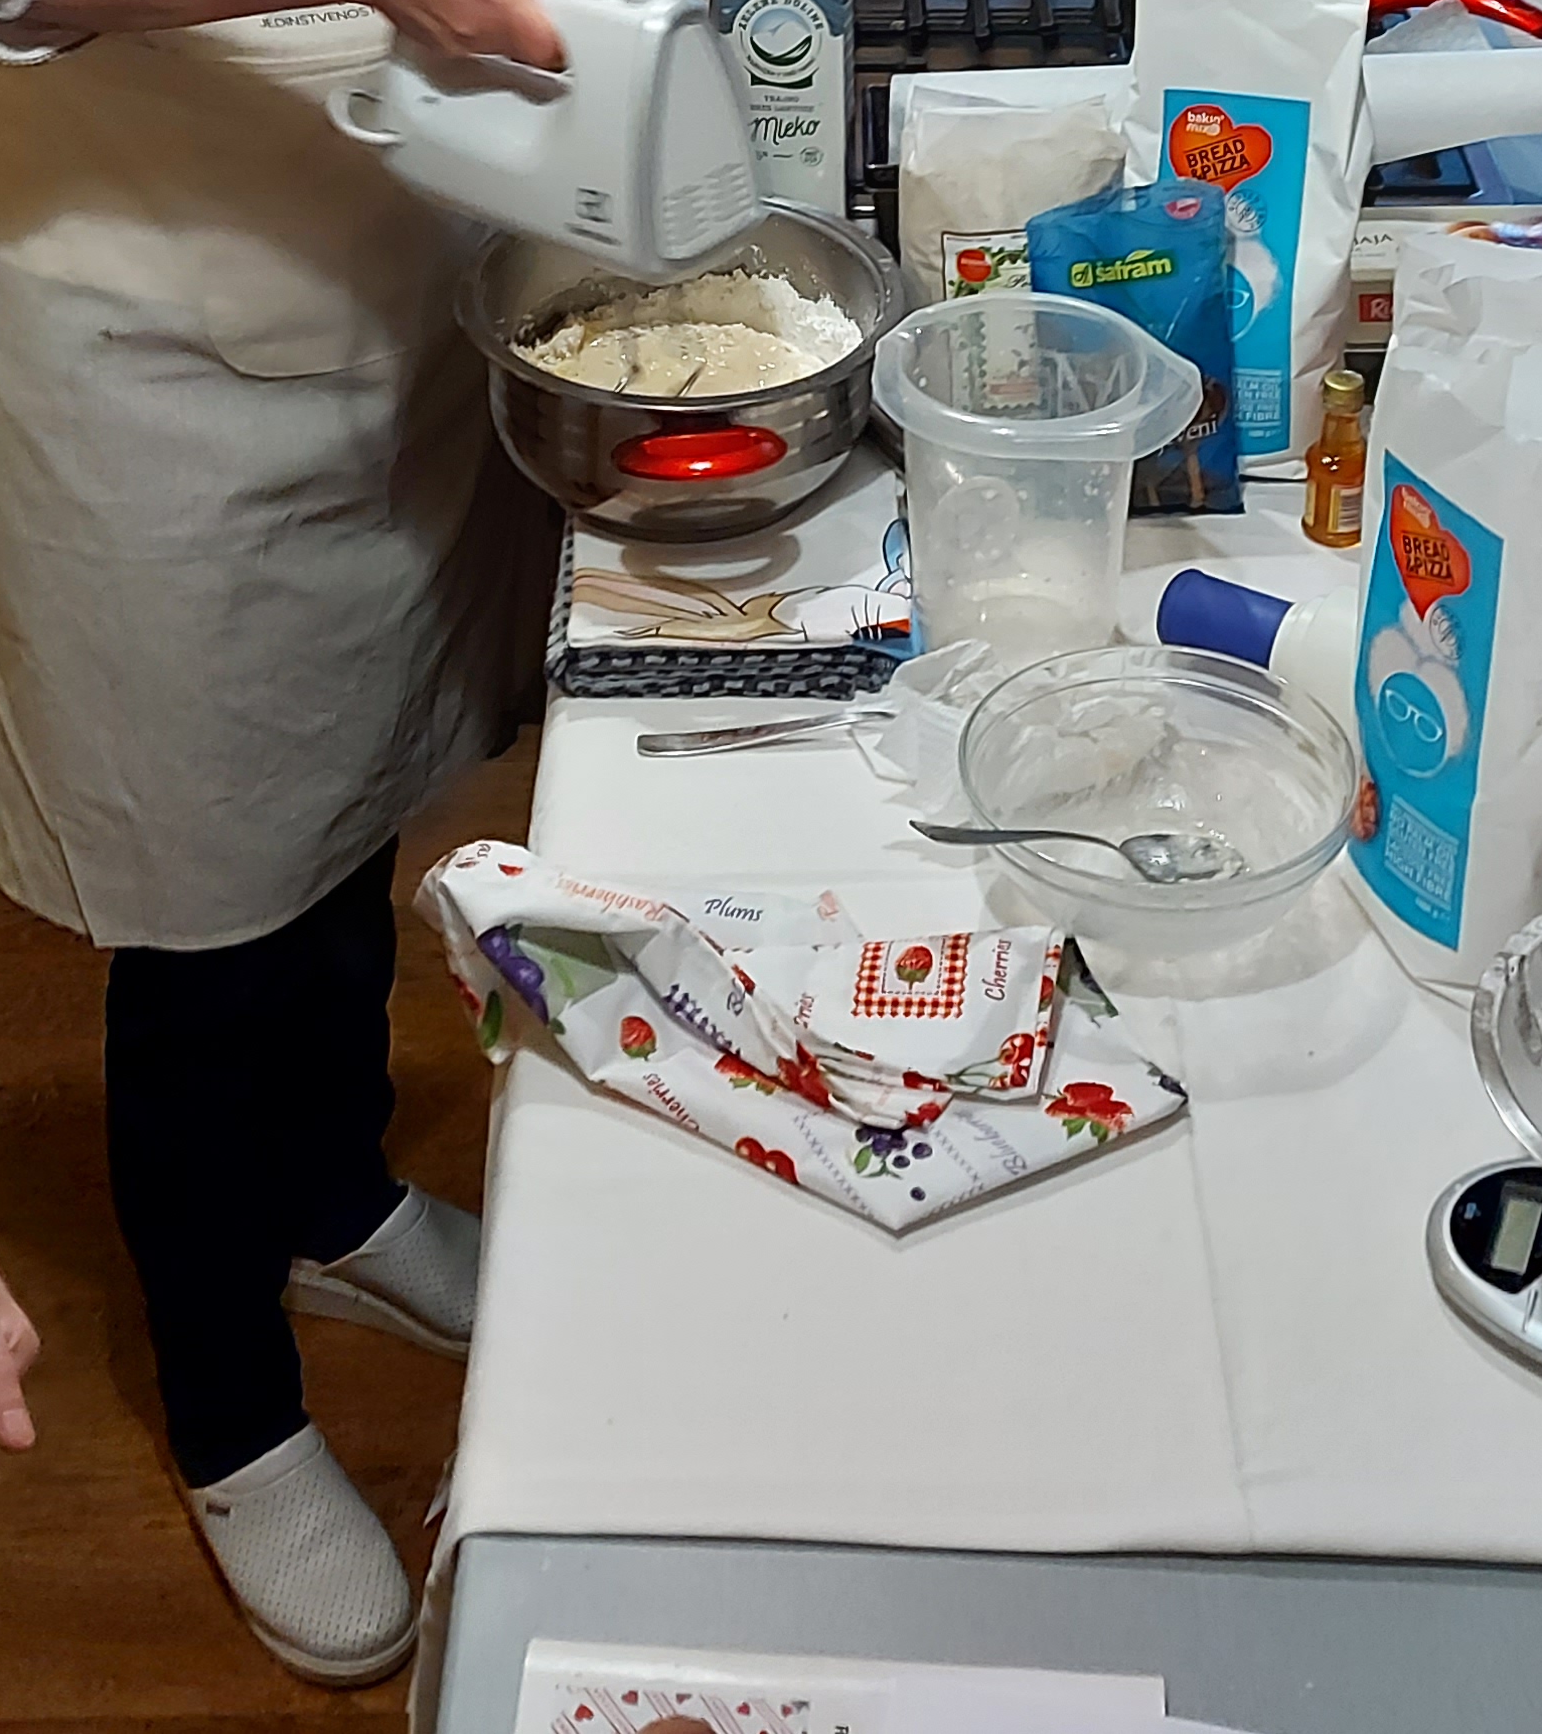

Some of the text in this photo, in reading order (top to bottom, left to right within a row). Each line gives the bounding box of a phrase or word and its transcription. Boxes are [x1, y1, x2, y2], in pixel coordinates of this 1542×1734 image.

[747, 114, 822, 146] Mleko
[1185, 138, 1246, 168] BREAD
[1190, 153, 1252, 180] &PIZZA
[1401, 534, 1450, 562] BREAD
[704, 895, 764, 923] Plums
[980, 938, 1012, 1003] Cherries
